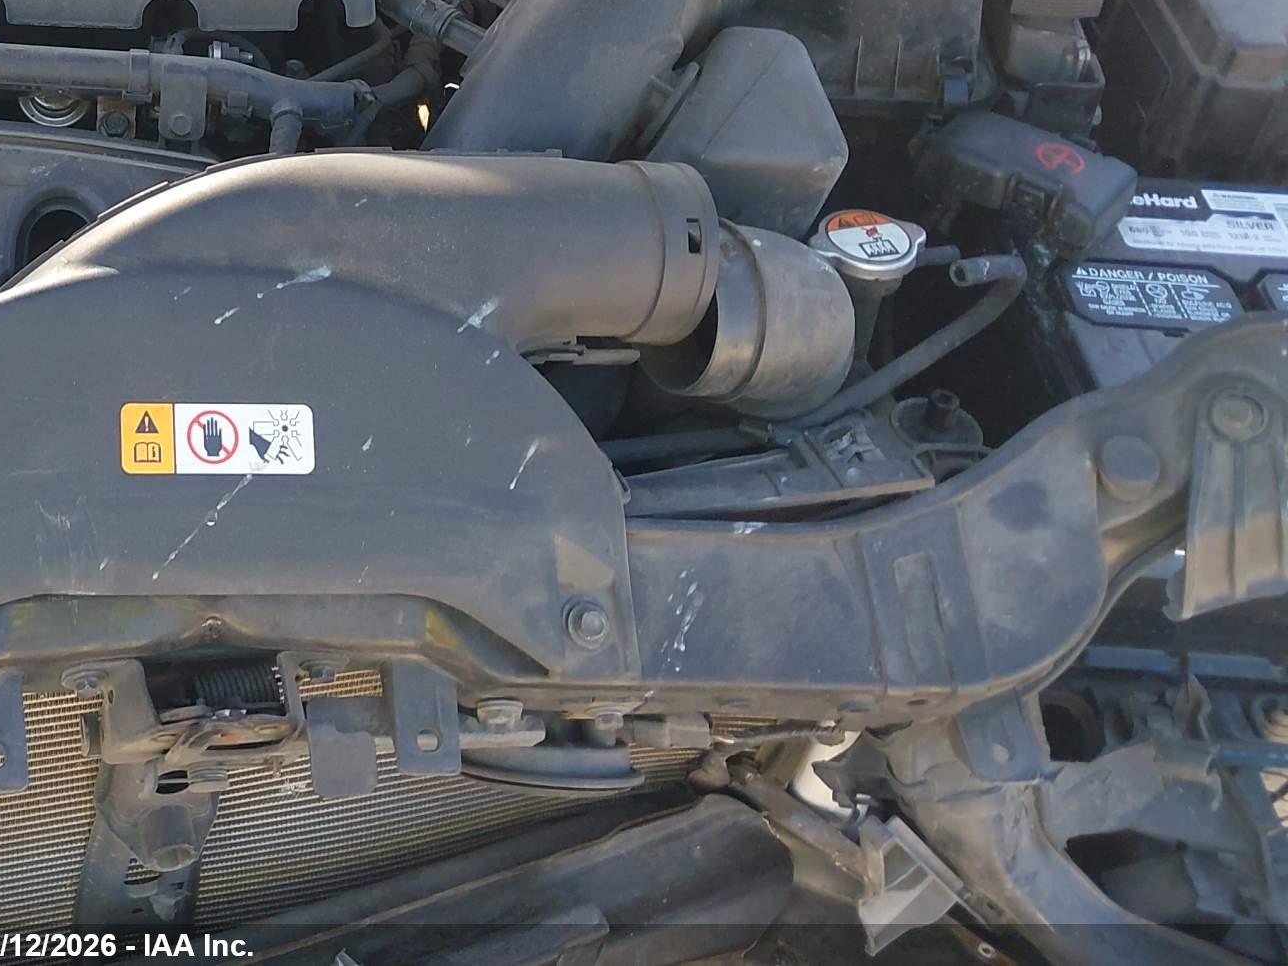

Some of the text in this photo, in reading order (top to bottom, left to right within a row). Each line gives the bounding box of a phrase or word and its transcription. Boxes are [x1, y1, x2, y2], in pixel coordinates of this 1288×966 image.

[1130, 193, 1198, 209] eHard
[1088, 267, 1144, 280] DANGER
[1158, 272, 1209, 284] POISON
